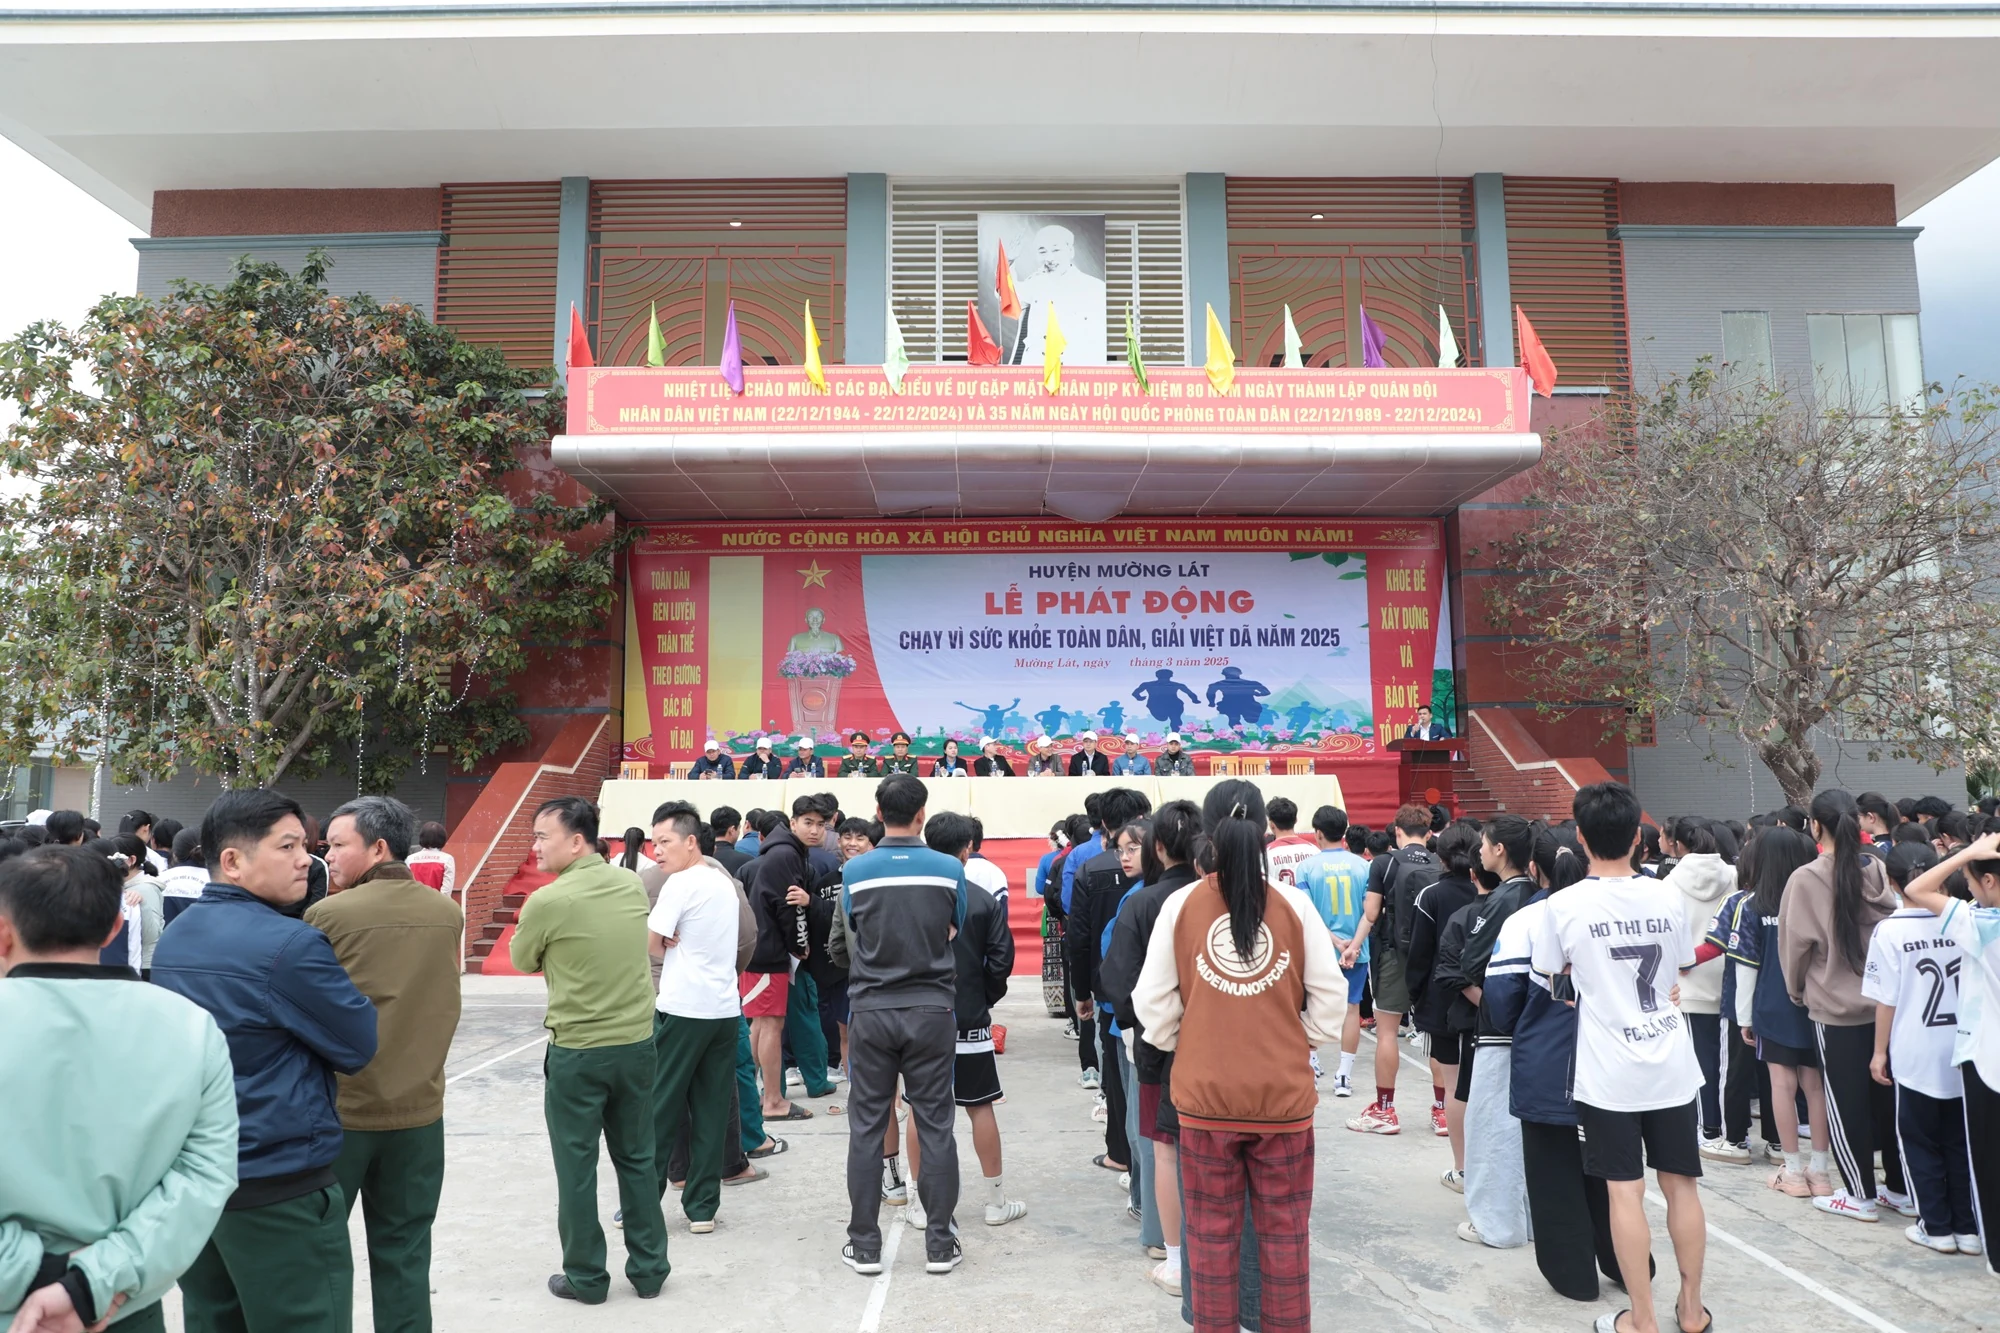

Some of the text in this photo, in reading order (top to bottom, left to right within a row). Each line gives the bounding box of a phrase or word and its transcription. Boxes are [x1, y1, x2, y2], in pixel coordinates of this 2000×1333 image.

[664, 380, 706, 400] NHIỆT
[710, 382, 739, 400] LIỆ
[744, 379, 784, 397] CHÀO
[788, 378, 832, 397] MỪNG
[836, 378, 864, 396] CÁC
[898, 376, 932, 396] BIỂU
[935, 376, 954, 396] VỀ
[956, 380, 978, 400] DỰ
[980, 378, 1009, 400] GẶP
[1014, 378, 1044, 400] MẶT
[1049, 378, 1090, 396] HÂN
[1094, 382, 1116, 400] DỊP
[1187, 383, 1204, 398] 80
[1208, 383, 1241, 398] NM
[1245, 379, 1282, 398] NGÀY
[1288, 380, 1336, 398] THÀNH
[1339, 380, 1366, 400] LẬP
[1370, 381, 1410, 398] QUÂN
[1412, 381, 1438, 400] ĐỘI
[620, 404, 660, 422] NHÂN
[664, 404, 694, 422] DÂN
[698, 404, 730, 425] VIỆT
[733, 407, 767, 422] NAM
[771, 406, 860, 423] (22/12/1944
[874, 406, 962, 422] 22/12/2024)
[966, 403, 986, 421] VÀ
[989, 406, 1007, 421] 35
[1011, 403, 1044, 421] NĂM
[1048, 404, 1088, 421] NGÀY
[1092, 404, 1116, 424] HỘI
[1120, 402, 1160, 422] QUỐC
[1164, 404, 1214, 422] PHÒNG
[1218, 404, 1256, 422] TOÀN
[1260, 405, 1290, 422] DÂN
[1294, 407, 1382, 423] (22/12/1989
[1394, 407, 1482, 424] 22/12/2024)
[722, 525, 1354, 548] NƯỚC CỘNG HÒA XÃ HỘI CHỦ NGHĨA VIỆT NAM MUÔN NĂM!
[651, 566, 690, 590] TOÀN DÂN
[1029, 560, 1210, 582] HUYỆN MƯỜNG LÁT
[1386, 560, 1426, 592] KHỎE ĐỂ
[653, 598, 696, 625] RÈN LUYỆN
[985, 583, 1254, 620] LỄ PHÁT ĐỘNG
[1381, 602, 1429, 634] XÂY DỰNG
[657, 626, 695, 654] THÂN THỂ
[900, 622, 1340, 654] CHẠY VÌ SỨC KHỎE TOÀN DÂN, GIẢI VIỆT DÃ NĂM 2025
[1014, 656, 1229, 670] Mường Lát, ngày tháng 3 năm 2025
[1400, 640, 1414, 668] VÀ
[652, 664, 701, 686] THEO GƯƠNG
[664, 693, 679, 717] BÁC
[1385, 676, 1420, 713] BẢO VỆ
[670, 726, 694, 754] VĨ ĐẠI
[1379, 714, 1392, 746] TỔ
[1273, 854, 1292, 866] Minh
[1325, 875, 1352, 916] 11
[1614, 920, 1642, 937] THỊ
[1646, 918, 1672, 934] GIA
[1606, 942, 1662, 1014] 7
